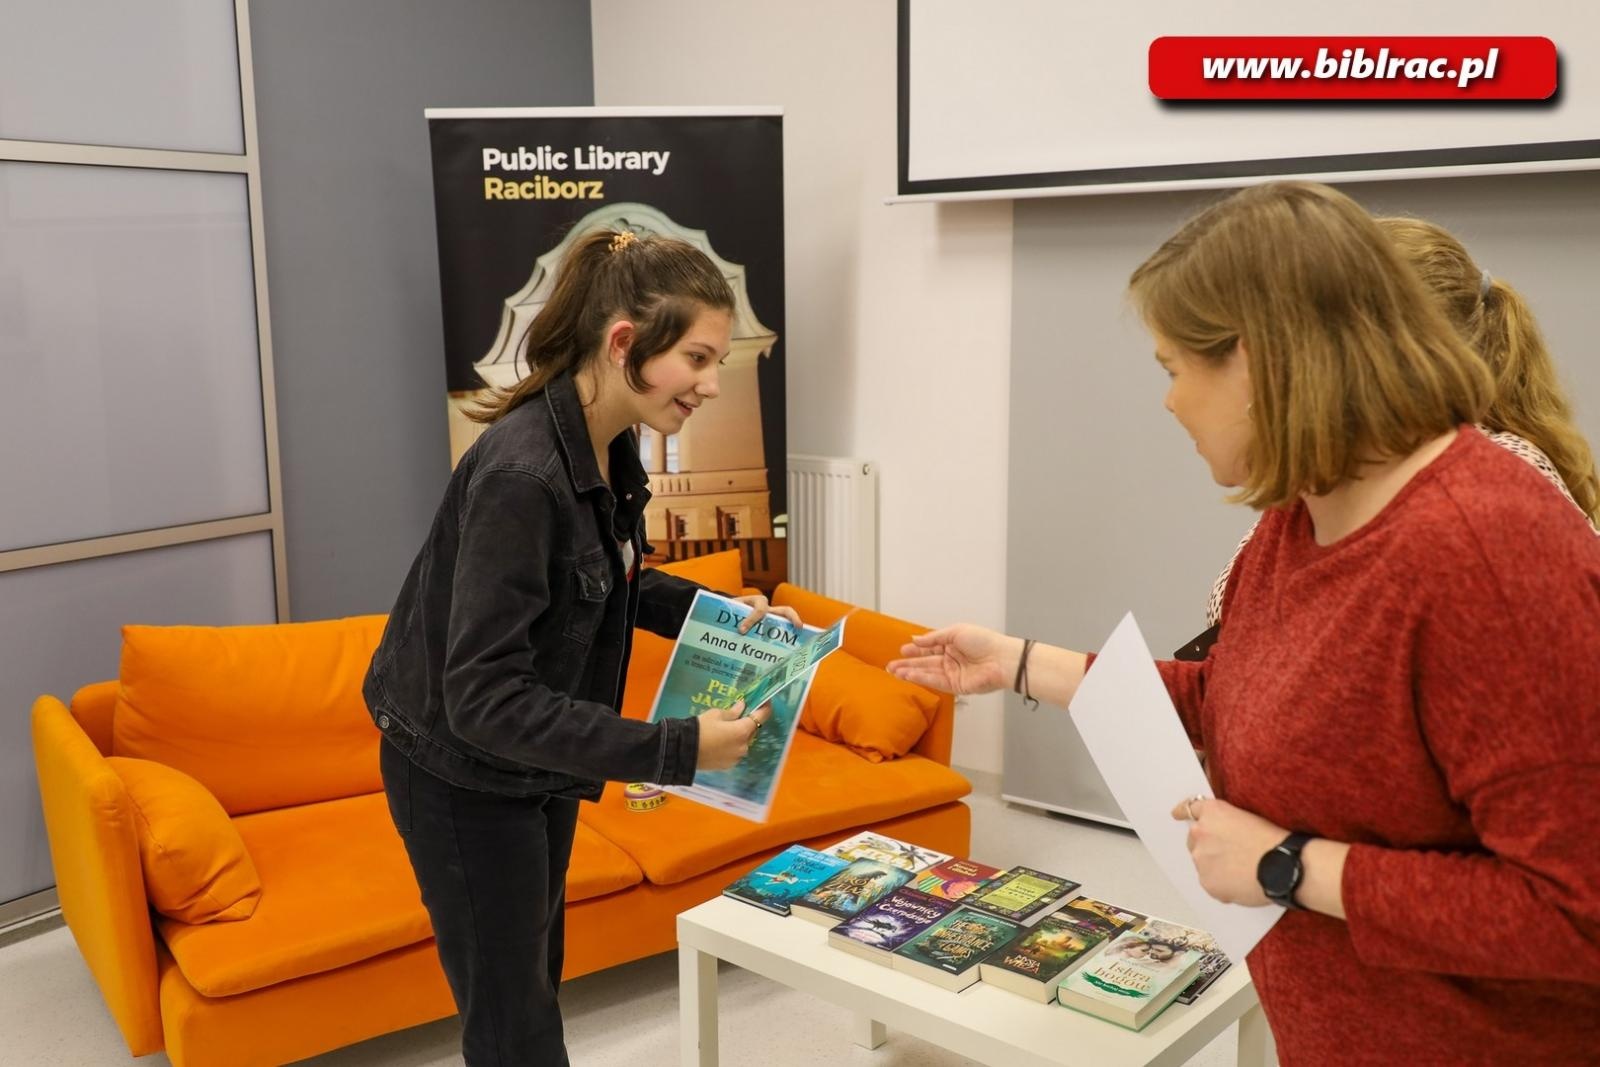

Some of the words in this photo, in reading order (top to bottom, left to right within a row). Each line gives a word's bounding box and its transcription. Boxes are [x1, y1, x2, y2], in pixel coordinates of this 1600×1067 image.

[482, 146, 569, 171] Public
[574, 145, 670, 176] Library
[484, 175, 604, 200] Raciborz
[716, 610, 799, 646] DYLOM
[700, 632, 738, 652] Anna
[891, 895, 942, 919] Wojownicy
[1094, 966, 1153, 991] bogów
[1109, 961, 1152, 983] Iskra
